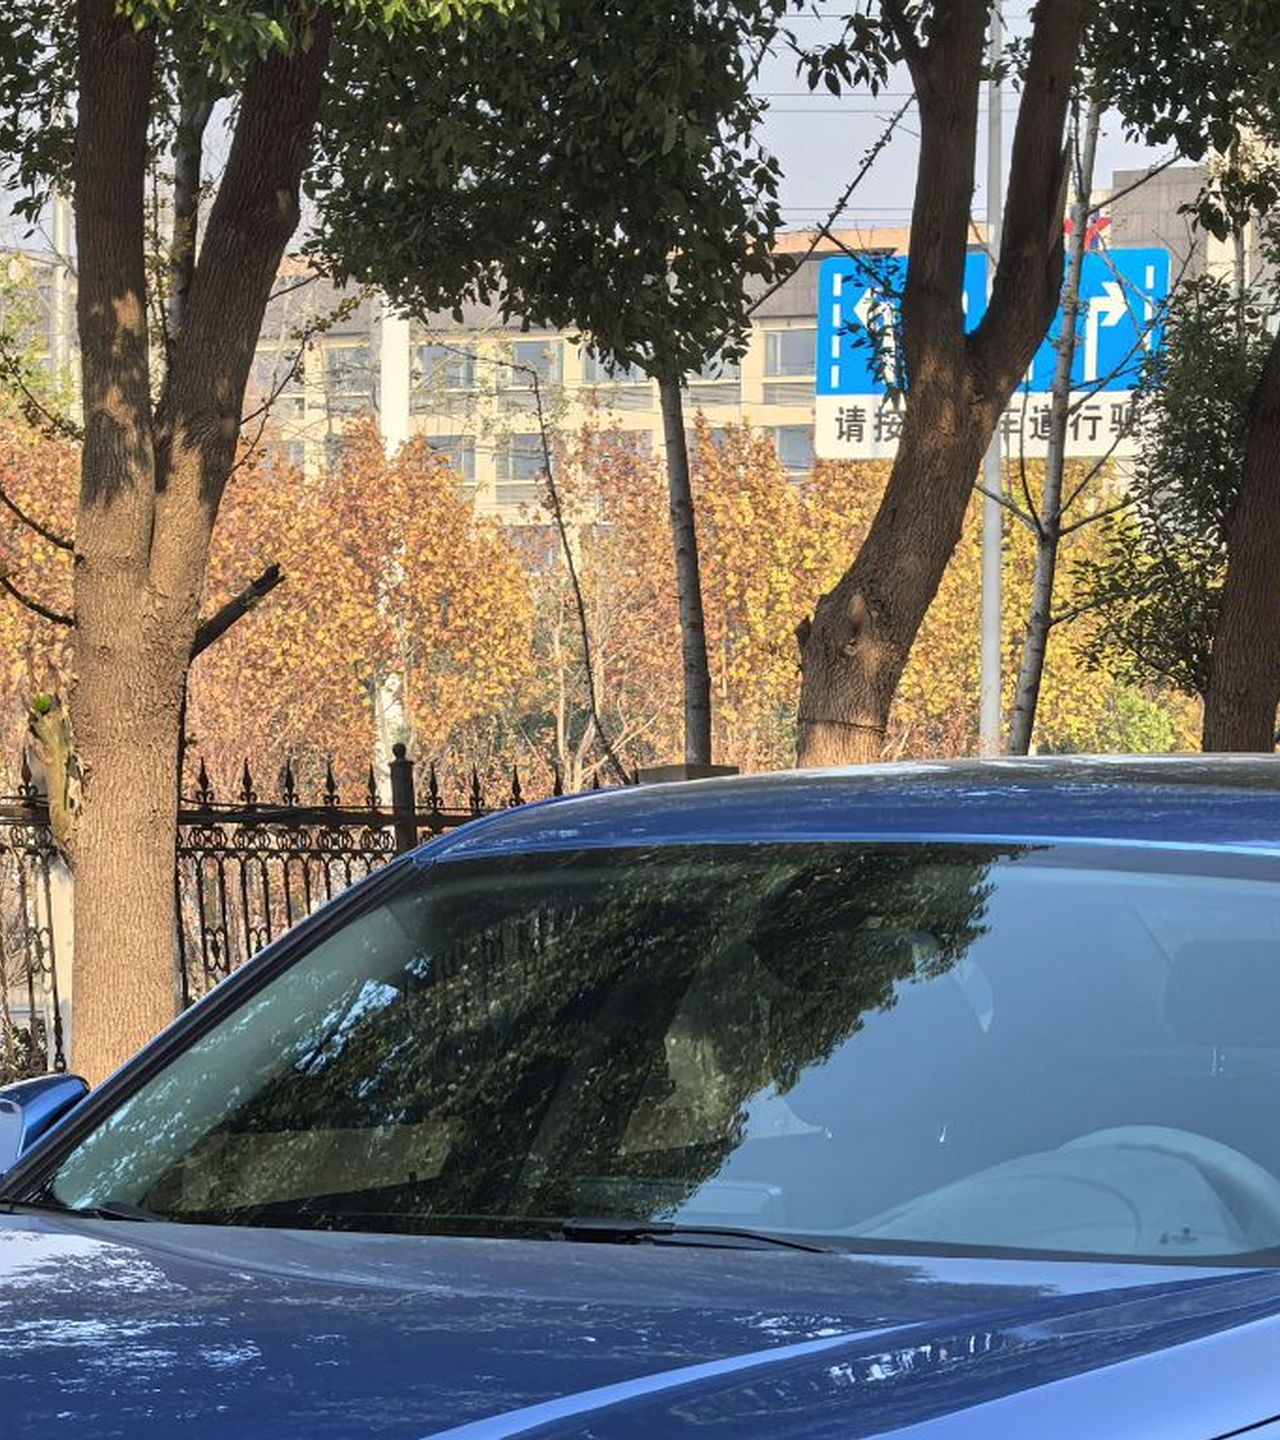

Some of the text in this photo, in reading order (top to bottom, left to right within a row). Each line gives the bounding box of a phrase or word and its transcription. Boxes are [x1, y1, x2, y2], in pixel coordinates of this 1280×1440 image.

[835, 404, 1140, 442] 请按车道行驶
